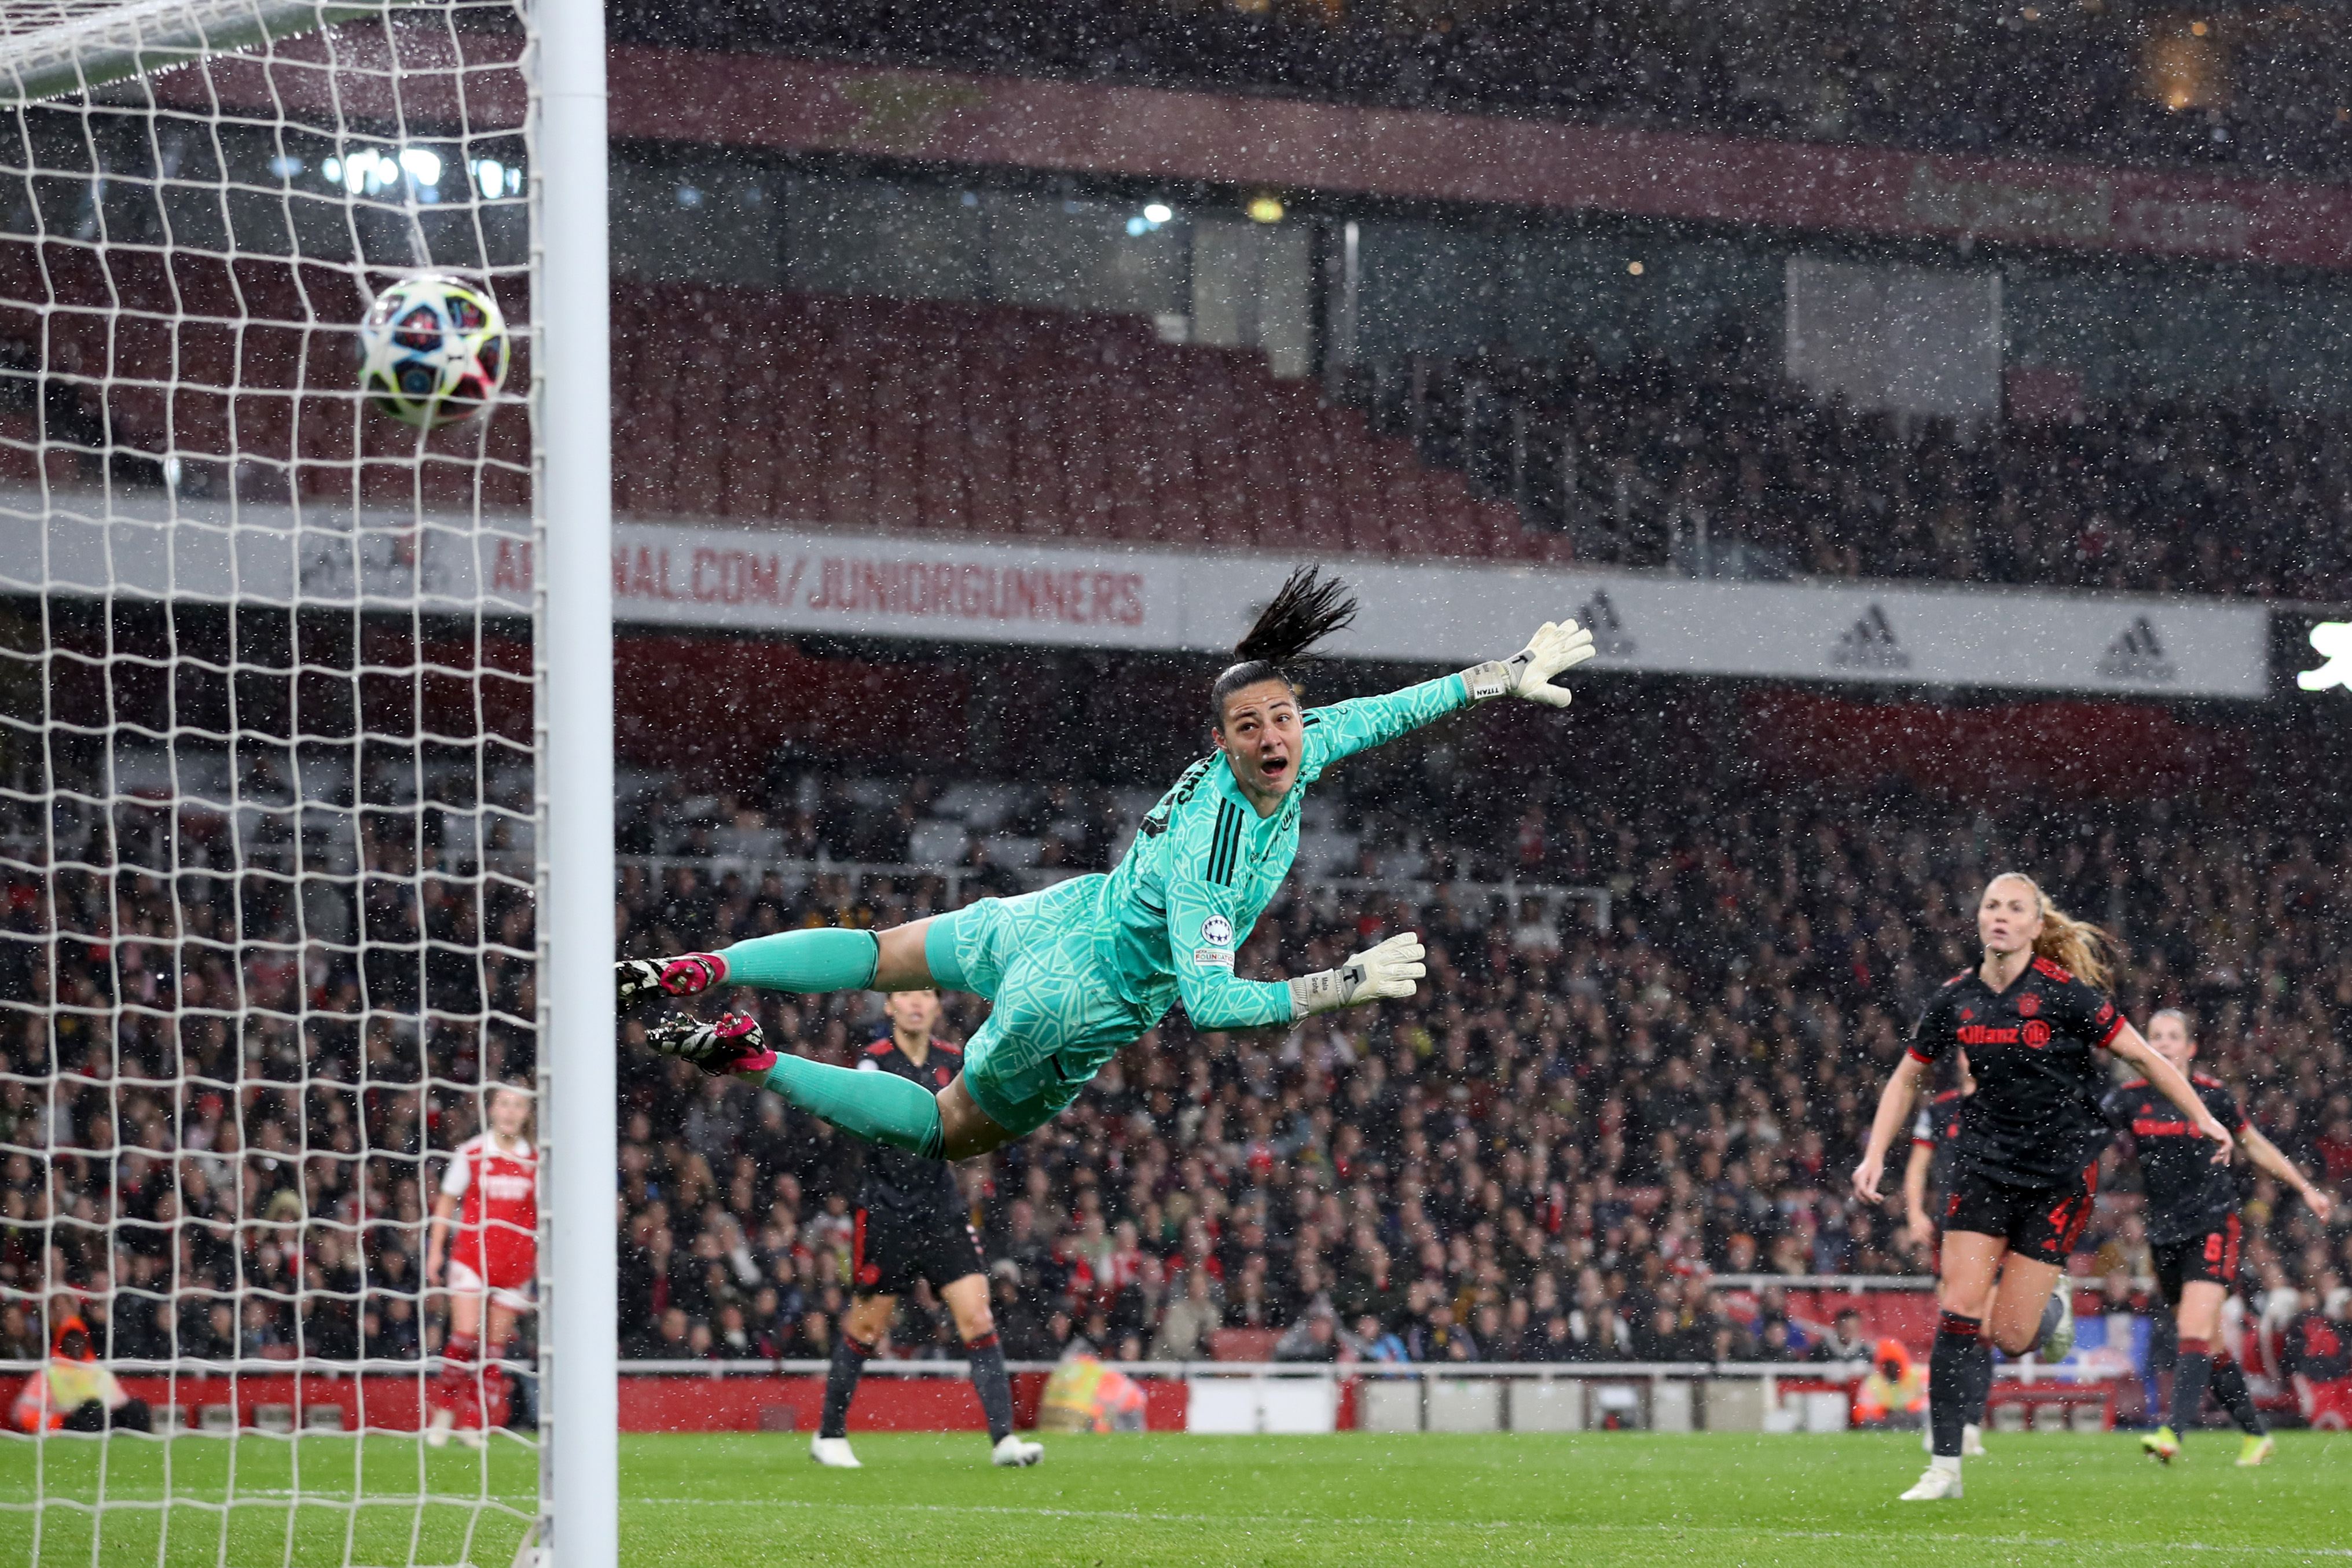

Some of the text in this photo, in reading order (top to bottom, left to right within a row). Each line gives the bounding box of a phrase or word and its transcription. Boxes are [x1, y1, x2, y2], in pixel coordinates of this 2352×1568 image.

[1195, 954, 1234, 962] FOUNDATIO
[1957, 1024, 2020, 1044] Allianz
[2048, 1196, 2074, 1234] 4
